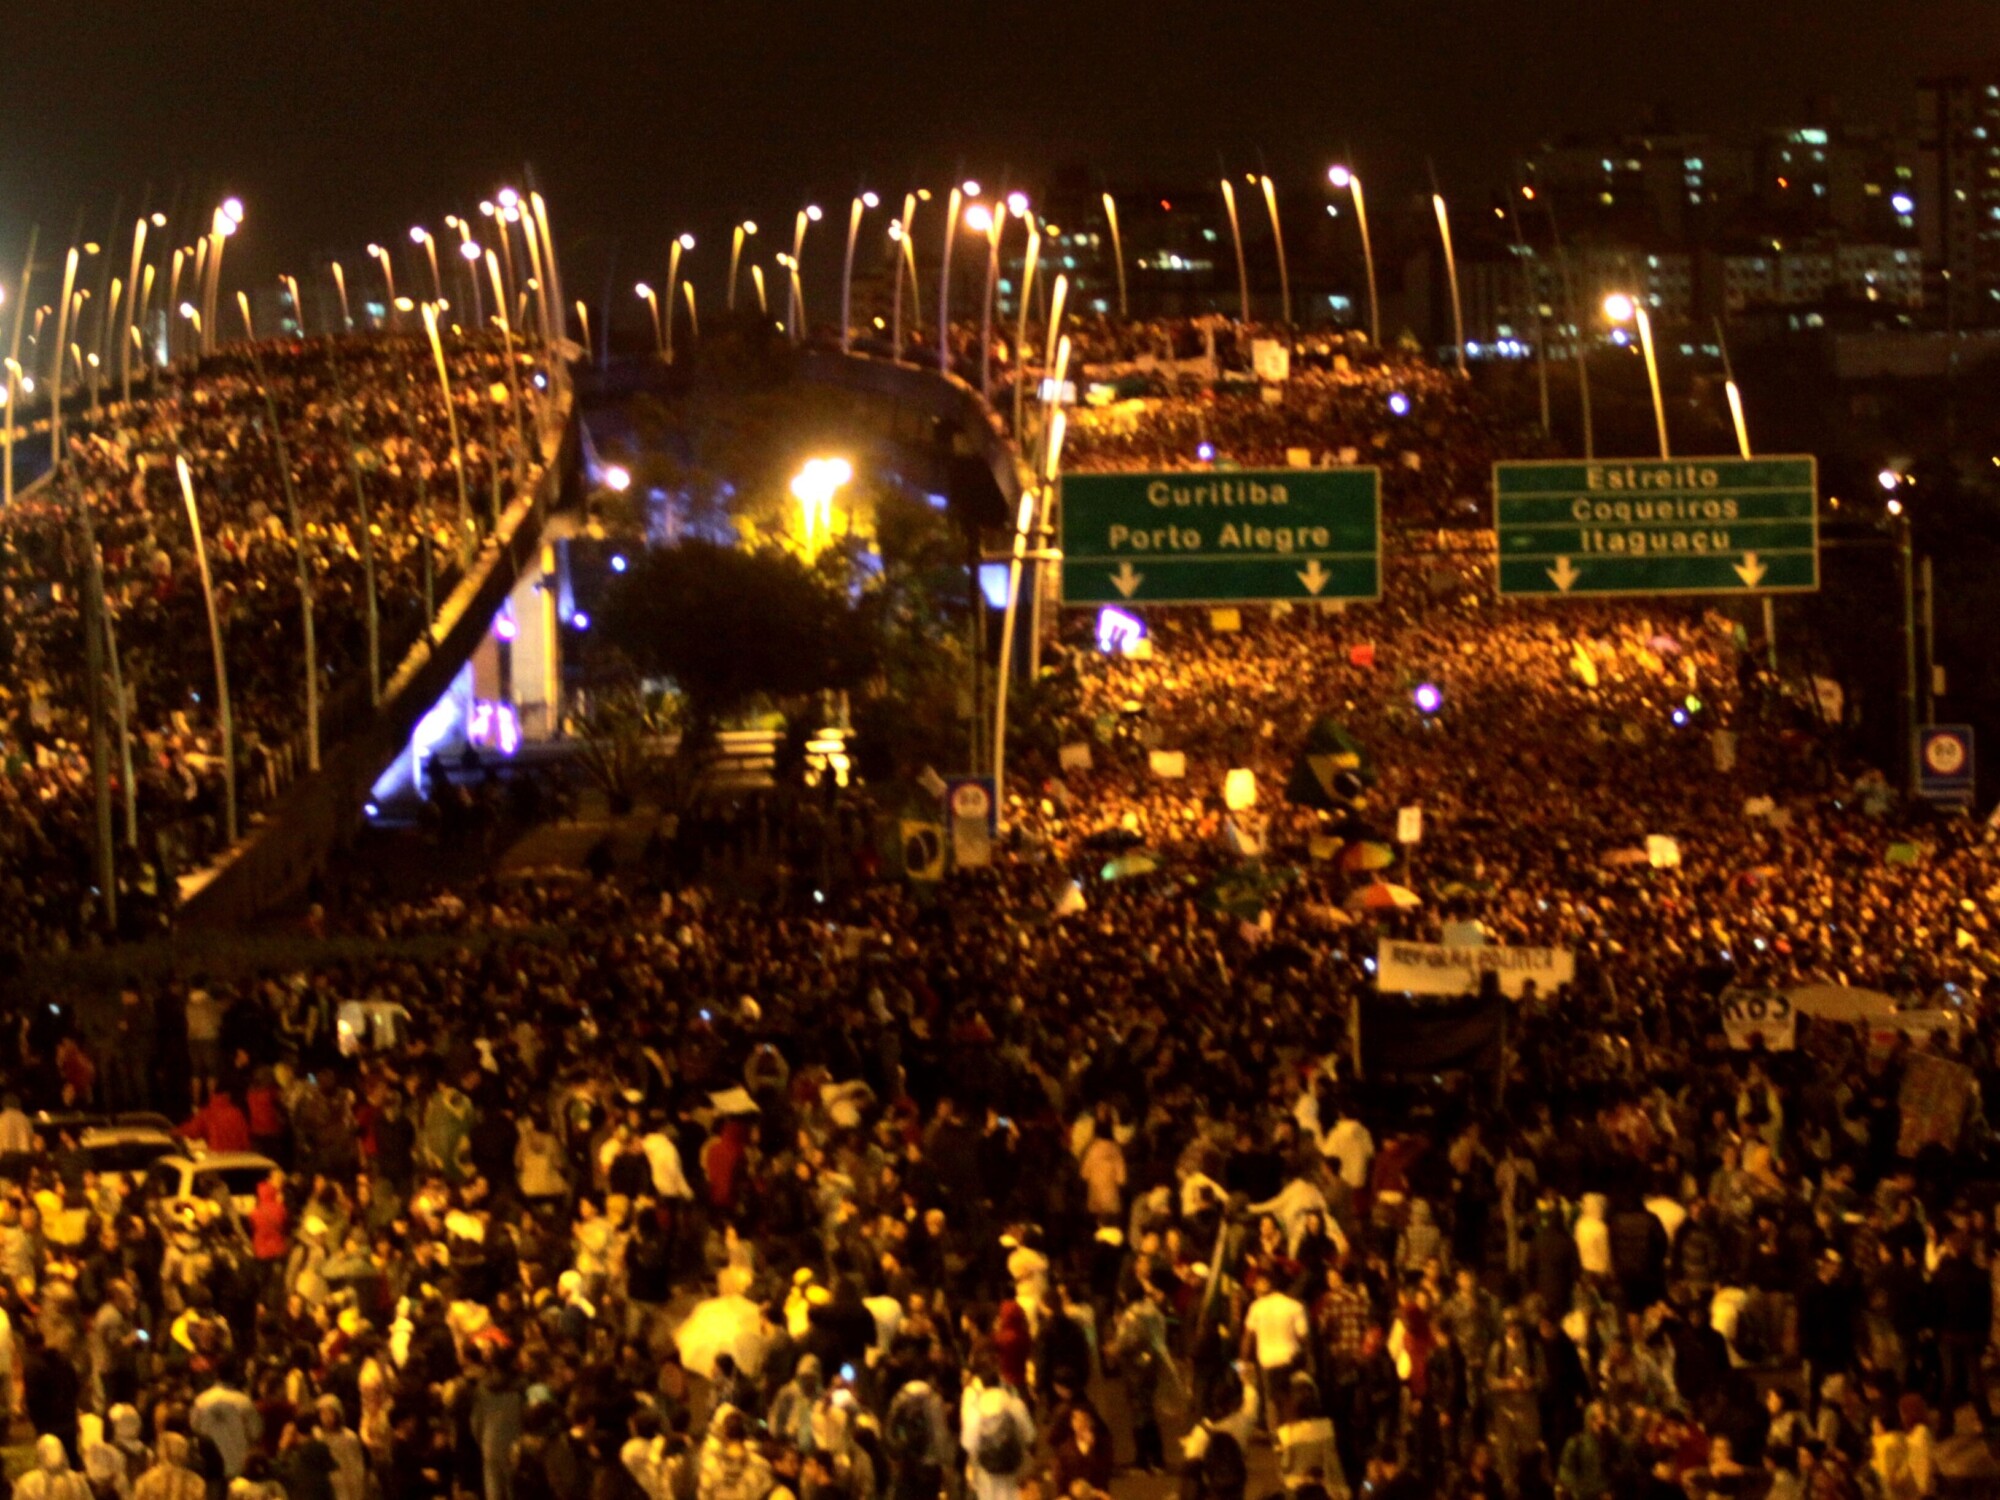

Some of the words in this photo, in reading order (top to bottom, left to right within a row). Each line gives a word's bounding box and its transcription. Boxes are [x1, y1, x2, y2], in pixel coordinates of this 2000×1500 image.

[1586, 465, 1719, 490] Estreito
[1147, 480, 1289, 507] Curitiba
[1571, 498, 1739, 523] Coqueiros
[1108, 523, 1202, 550] Porto
[1218, 522, 1331, 553] Alegre
[1581, 529, 1731, 555] Itaguaçu
